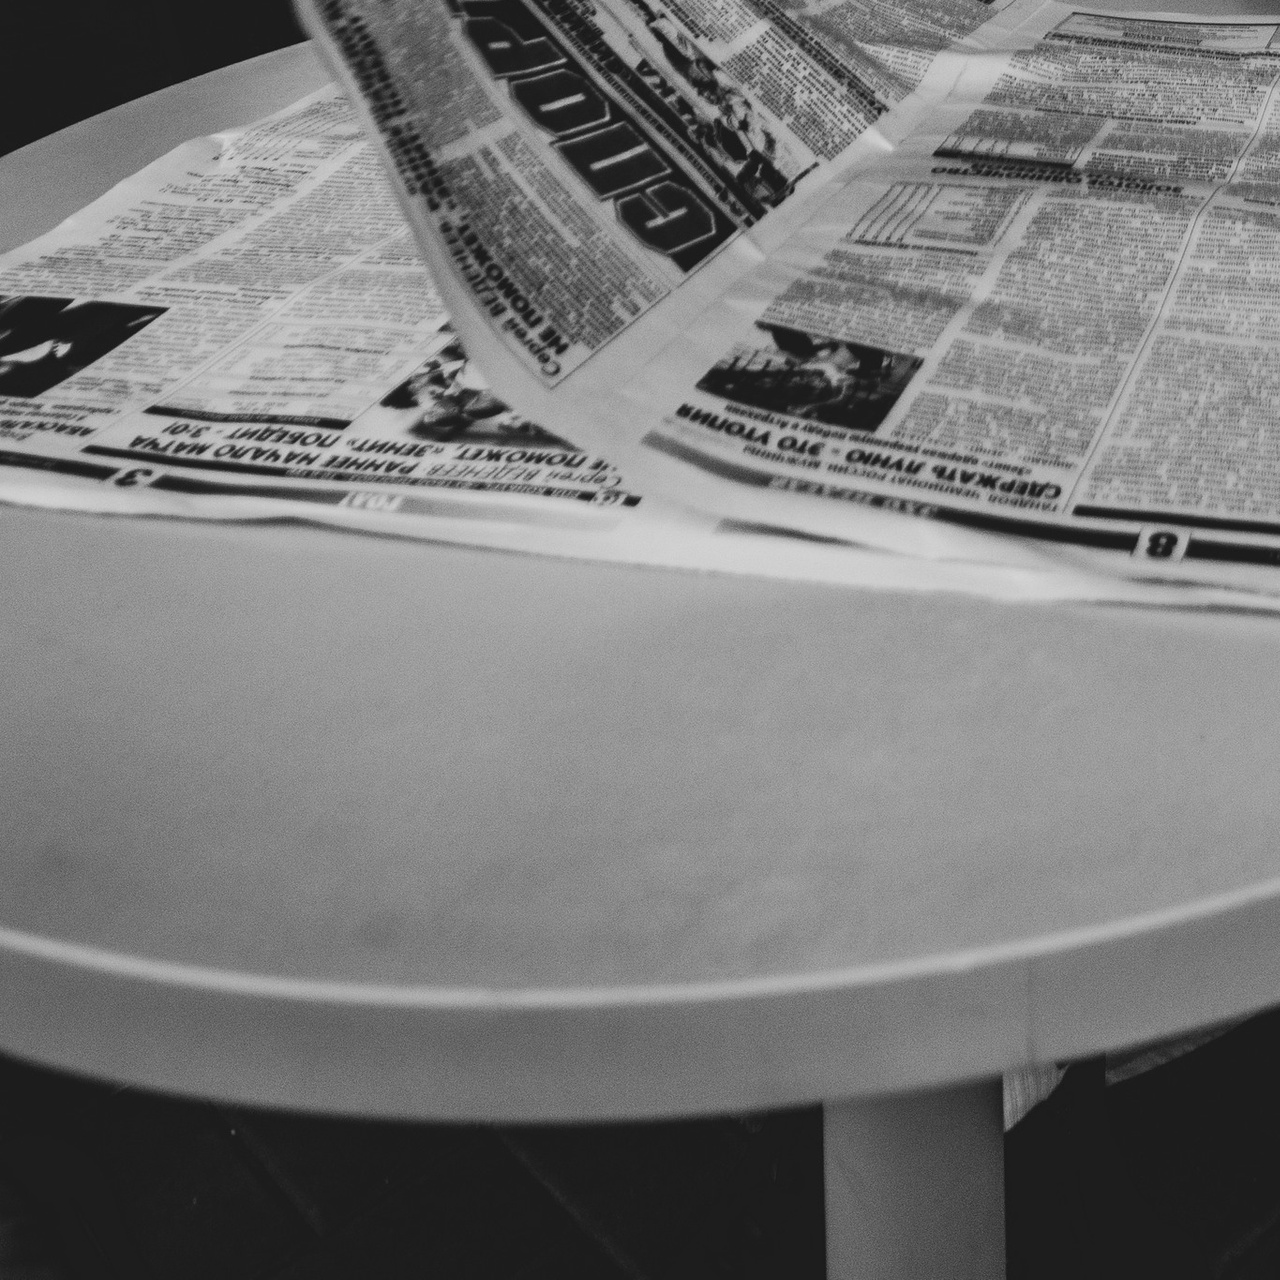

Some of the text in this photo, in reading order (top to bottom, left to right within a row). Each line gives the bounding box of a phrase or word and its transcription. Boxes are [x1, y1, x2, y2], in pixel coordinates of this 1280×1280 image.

[224, 425, 342, 449] ПОБЕДИТ
[674, 403, 771, 447] УТОПИЯ
[127, 435, 212, 457] МАТЧА
[212, 443, 320, 467] НАЧАЛО
[346, 437, 445, 458] «ЗЕНИТ»
[454, 444, 588, 470] ПОМОЖЕТ,
[776, 436, 826, 458] ЭТО
[319, 455, 421, 475] РАННЕЕ
[844, 448, 927, 476] ЛУНЮ
[113, 468, 154, 488] 3
[931, 464, 1062, 500] СДЕРЖАТЬ
[1146, 531, 1179, 559] 8
